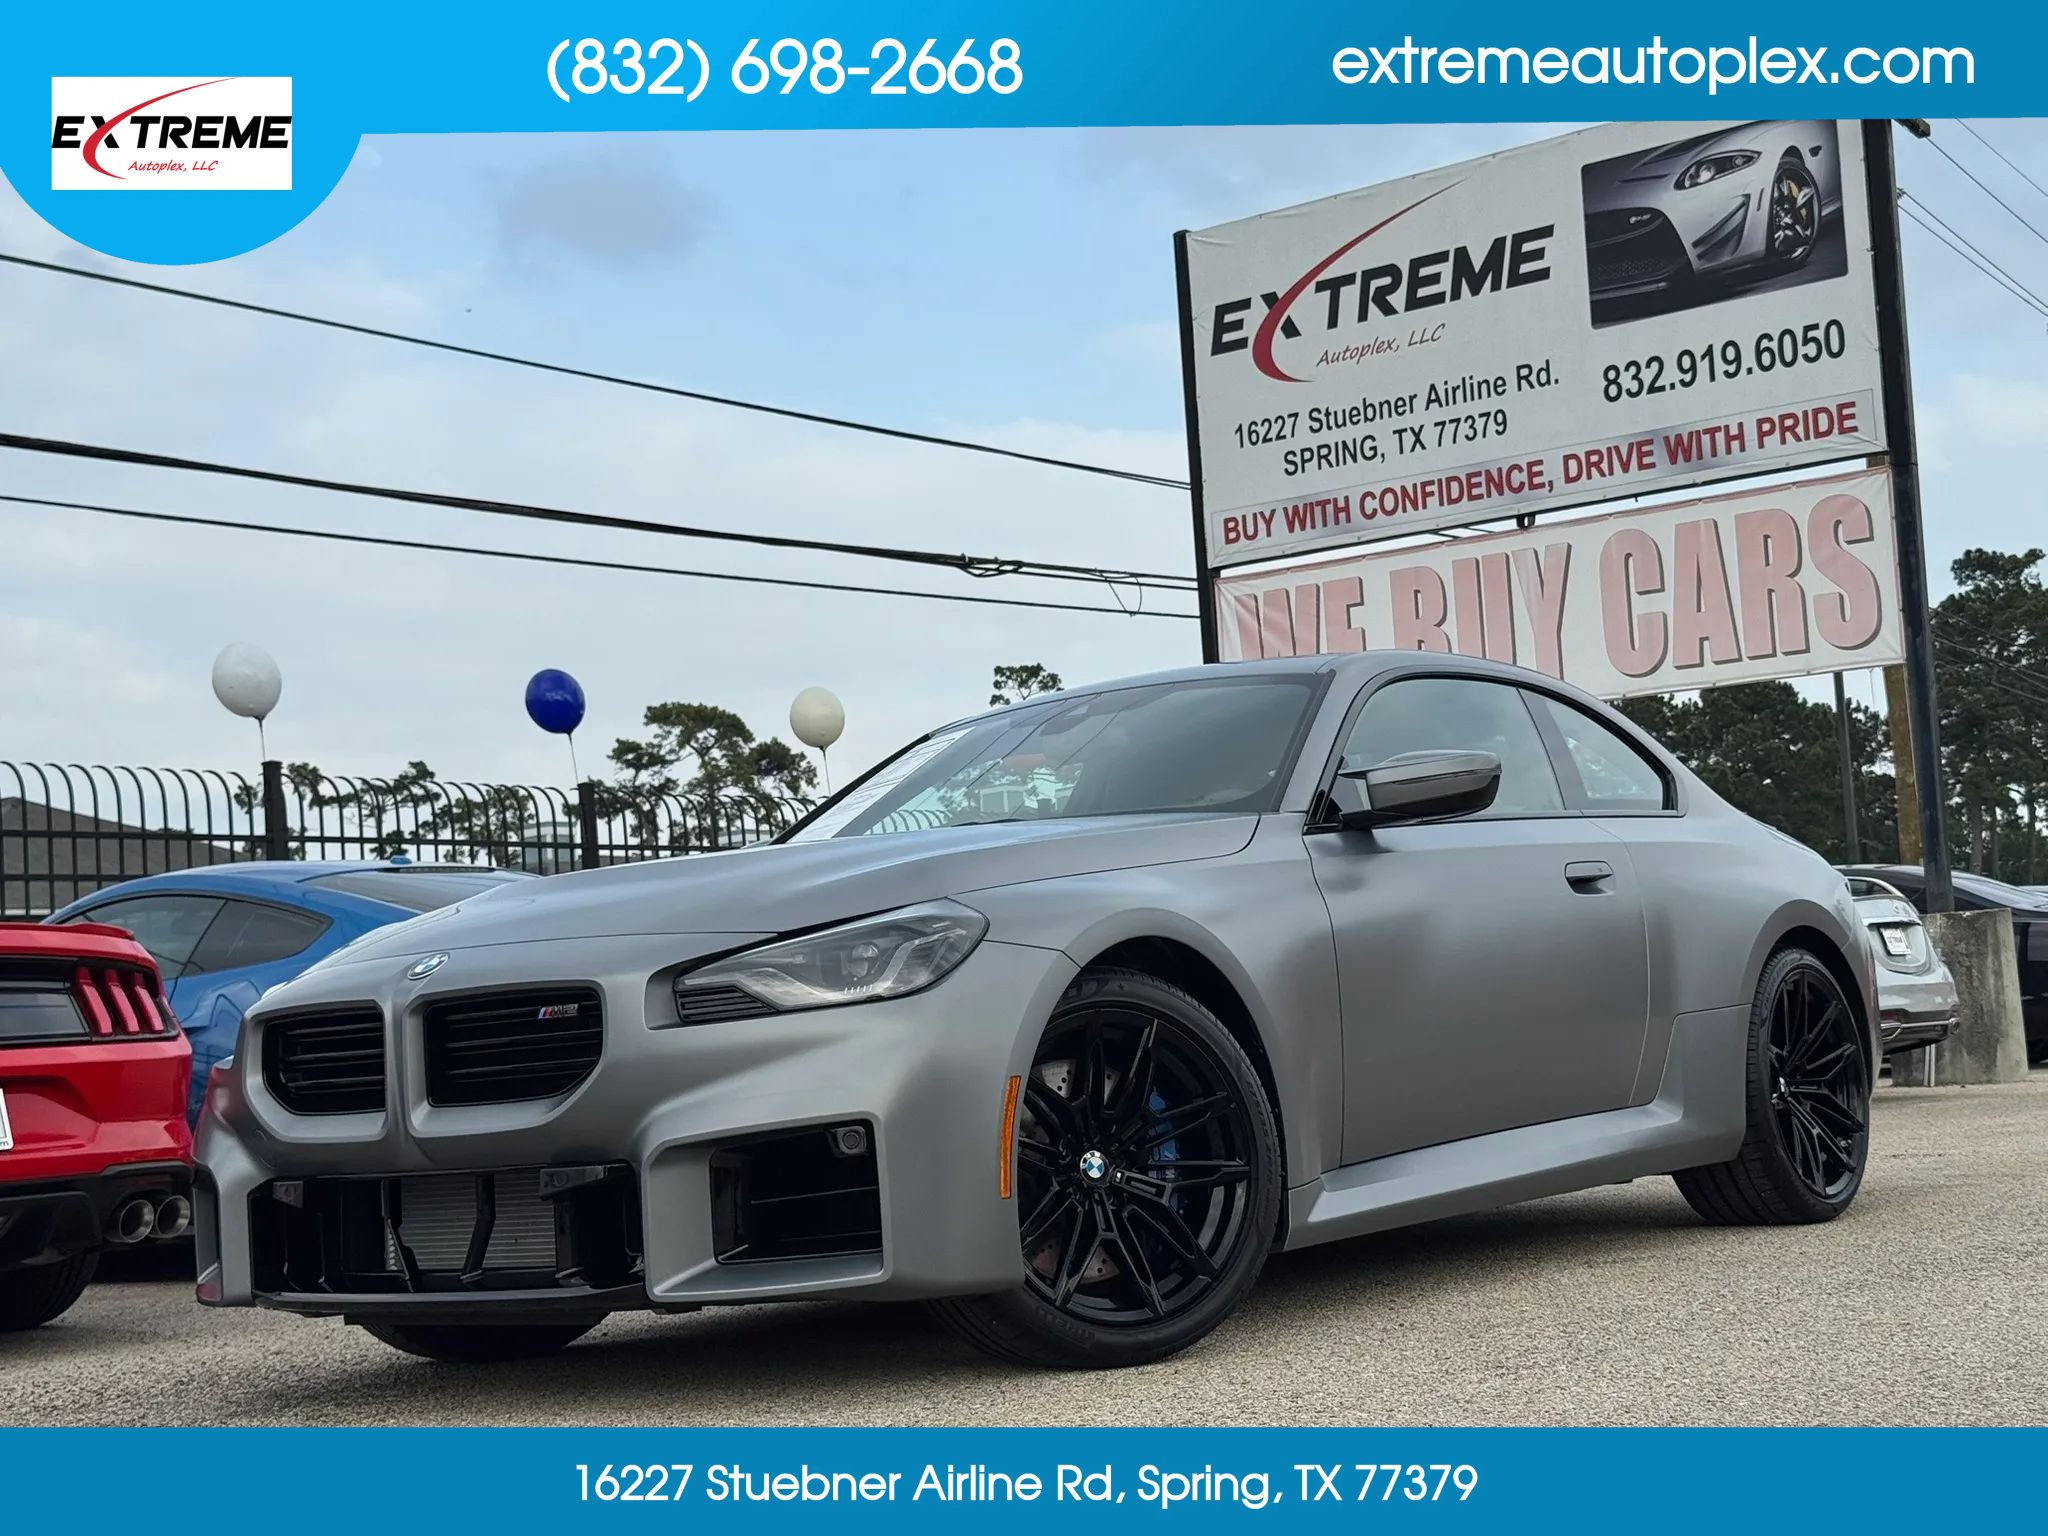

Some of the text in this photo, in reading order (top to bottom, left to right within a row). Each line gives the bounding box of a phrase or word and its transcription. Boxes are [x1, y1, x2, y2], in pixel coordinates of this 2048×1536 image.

[1210, 223, 1556, 357] EXTREME
[1315, 322, 1446, 368] Autoplex, LLC
[1602, 318, 1846, 403] 832.919.6050
[1234, 358, 1560, 449] 16227 Stuebner Airline Rd.
[1283, 408, 1509, 478] SPRING, TX 77379
[1223, 401, 1859, 546] BUY WITH CONFIDENCE, DRIVE WITH PRIDE
[1389, 542, 1573, 681] BUY
[1599, 493, 1883, 679] CARS
